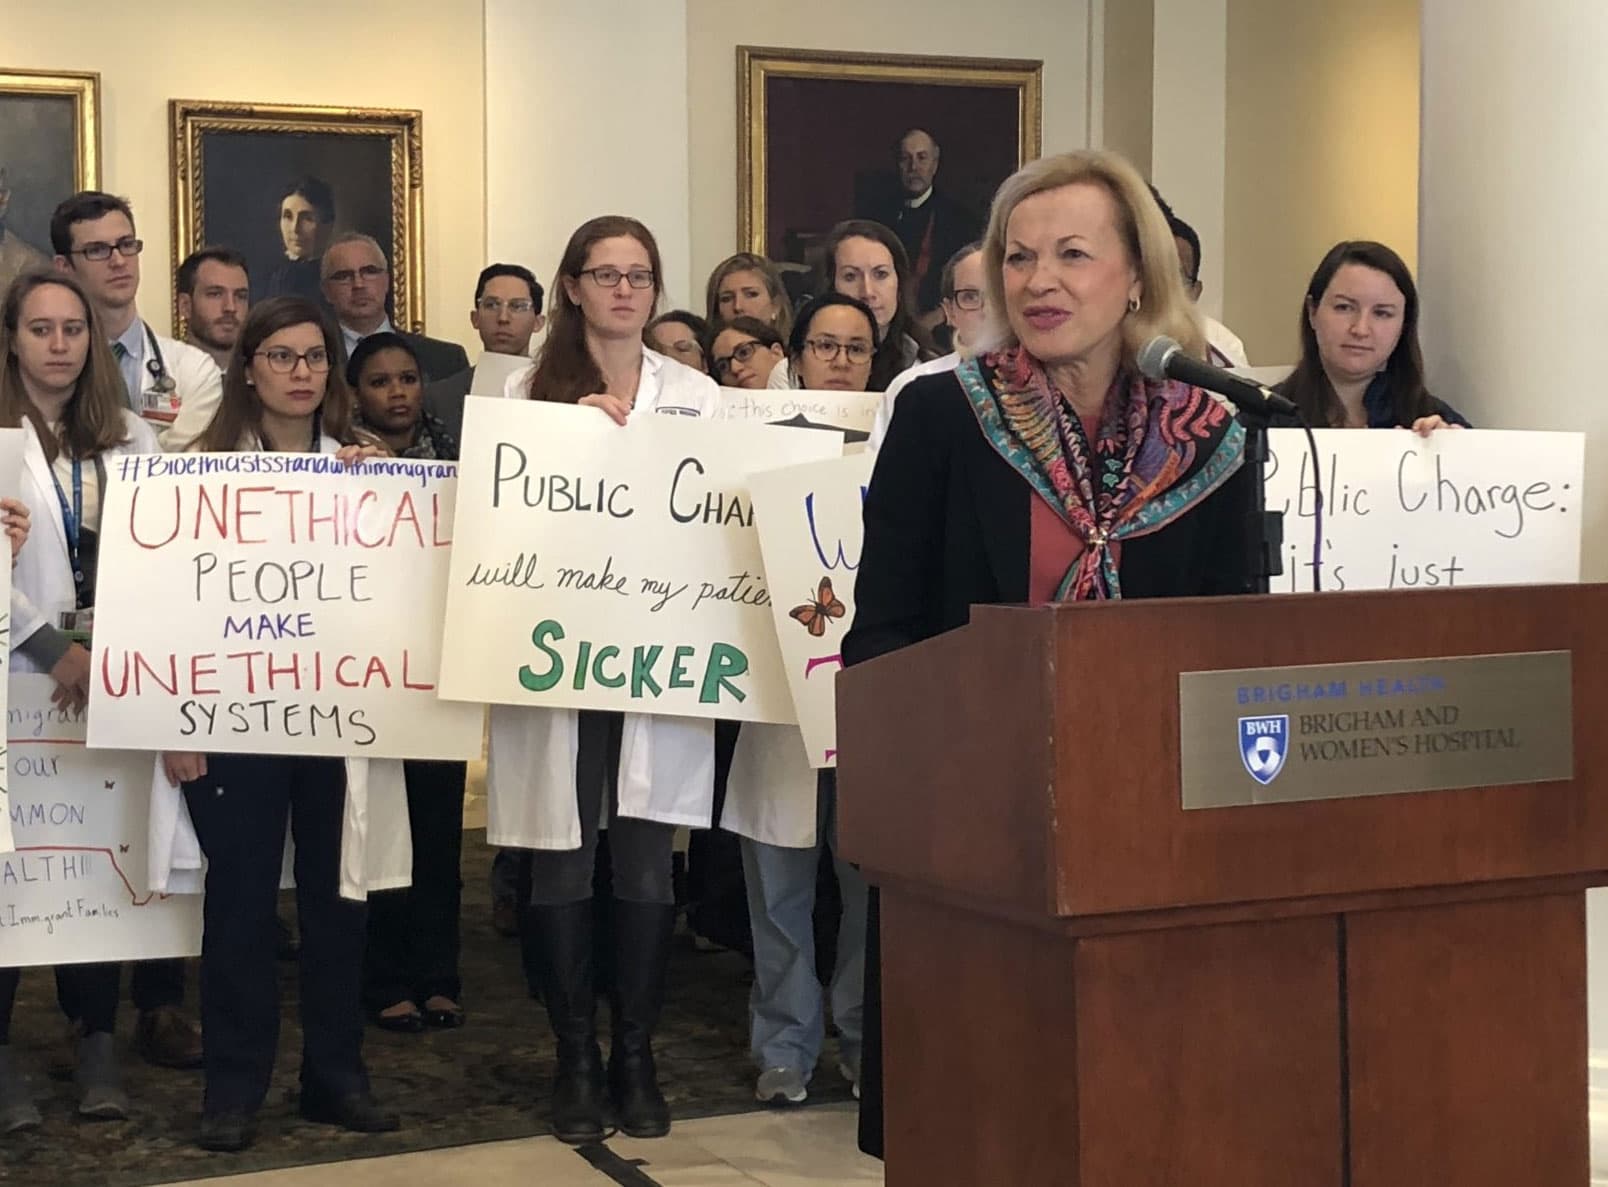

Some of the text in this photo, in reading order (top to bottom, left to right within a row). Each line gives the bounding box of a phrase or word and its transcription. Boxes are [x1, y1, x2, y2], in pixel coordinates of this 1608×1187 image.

[737, 396, 773, 418] this
[781, 399, 827, 418] choice
[669, 457, 755, 527] CHA
[1264, 449, 1570, 538] blic Charge:
[130, 484, 452, 549] UNETHICAL
[194, 552, 374, 604] PEOPLE
[466, 553, 772, 611] will make my patie
[1388, 544, 1464, 589] just
[224, 612, 316, 640] MAKE
[102, 645, 435, 698] UNETHICAL
[519, 619, 750, 704] SICKER
[1236, 680, 1347, 704] BRIGHAM
[180, 700, 377, 746] SYSTEMS
[1245, 719, 1282, 736] BWH
[1300, 705, 1460, 736] BRIGHAM AND
[15, 754, 61, 777] our
[1300, 728, 1521, 762] WOMEN'S HOSPITAL
